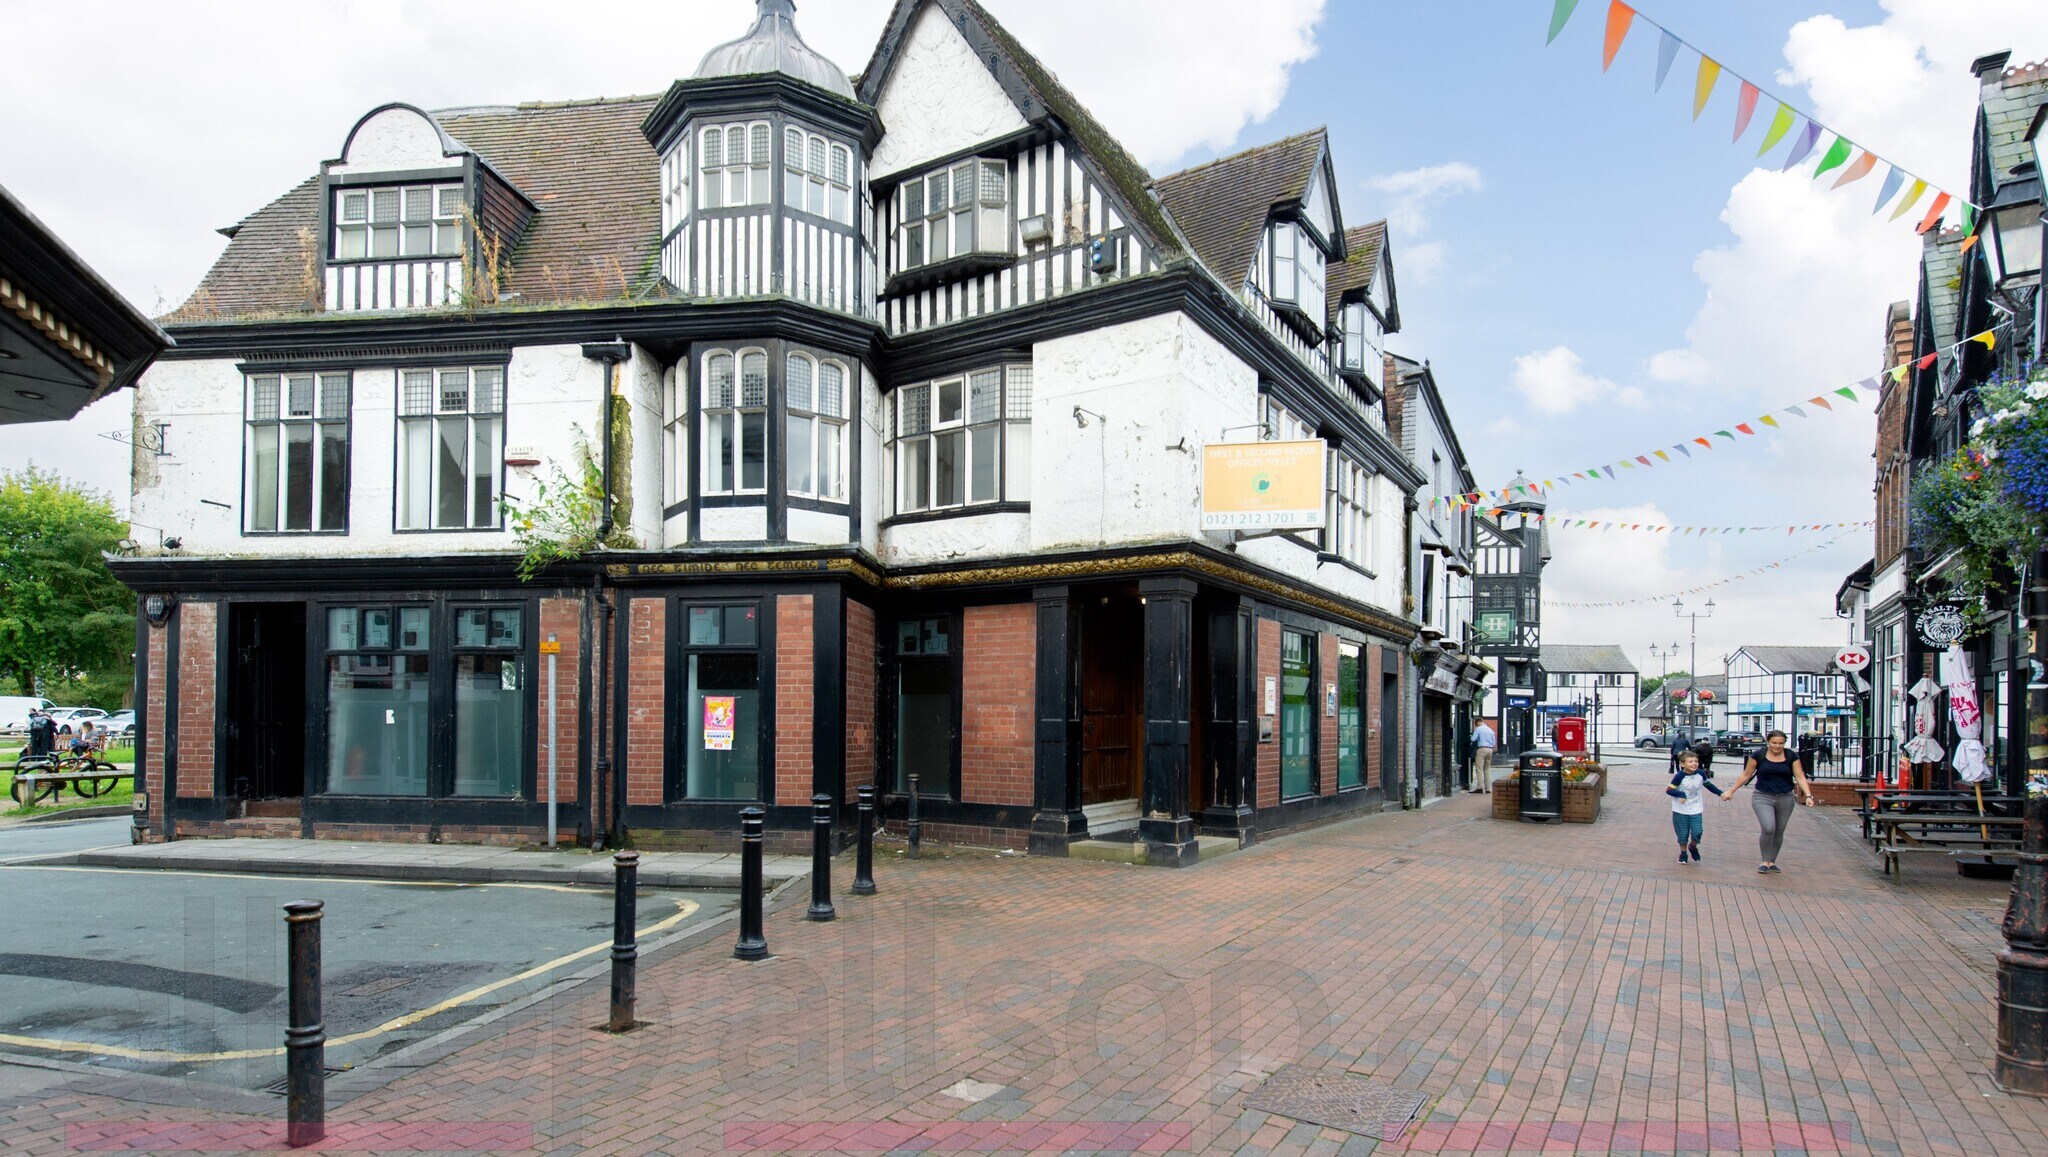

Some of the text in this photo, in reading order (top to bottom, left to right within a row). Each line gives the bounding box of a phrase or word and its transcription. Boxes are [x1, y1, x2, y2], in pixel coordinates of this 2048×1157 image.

[1209, 446, 1316, 458] FIRST & SECOND FLOOR
[1227, 457, 1296, 468] OFFICES TO LET
[1206, 513, 1294, 525] 0121 212 1701
[1915, 605, 1960, 630] THE SALTY
